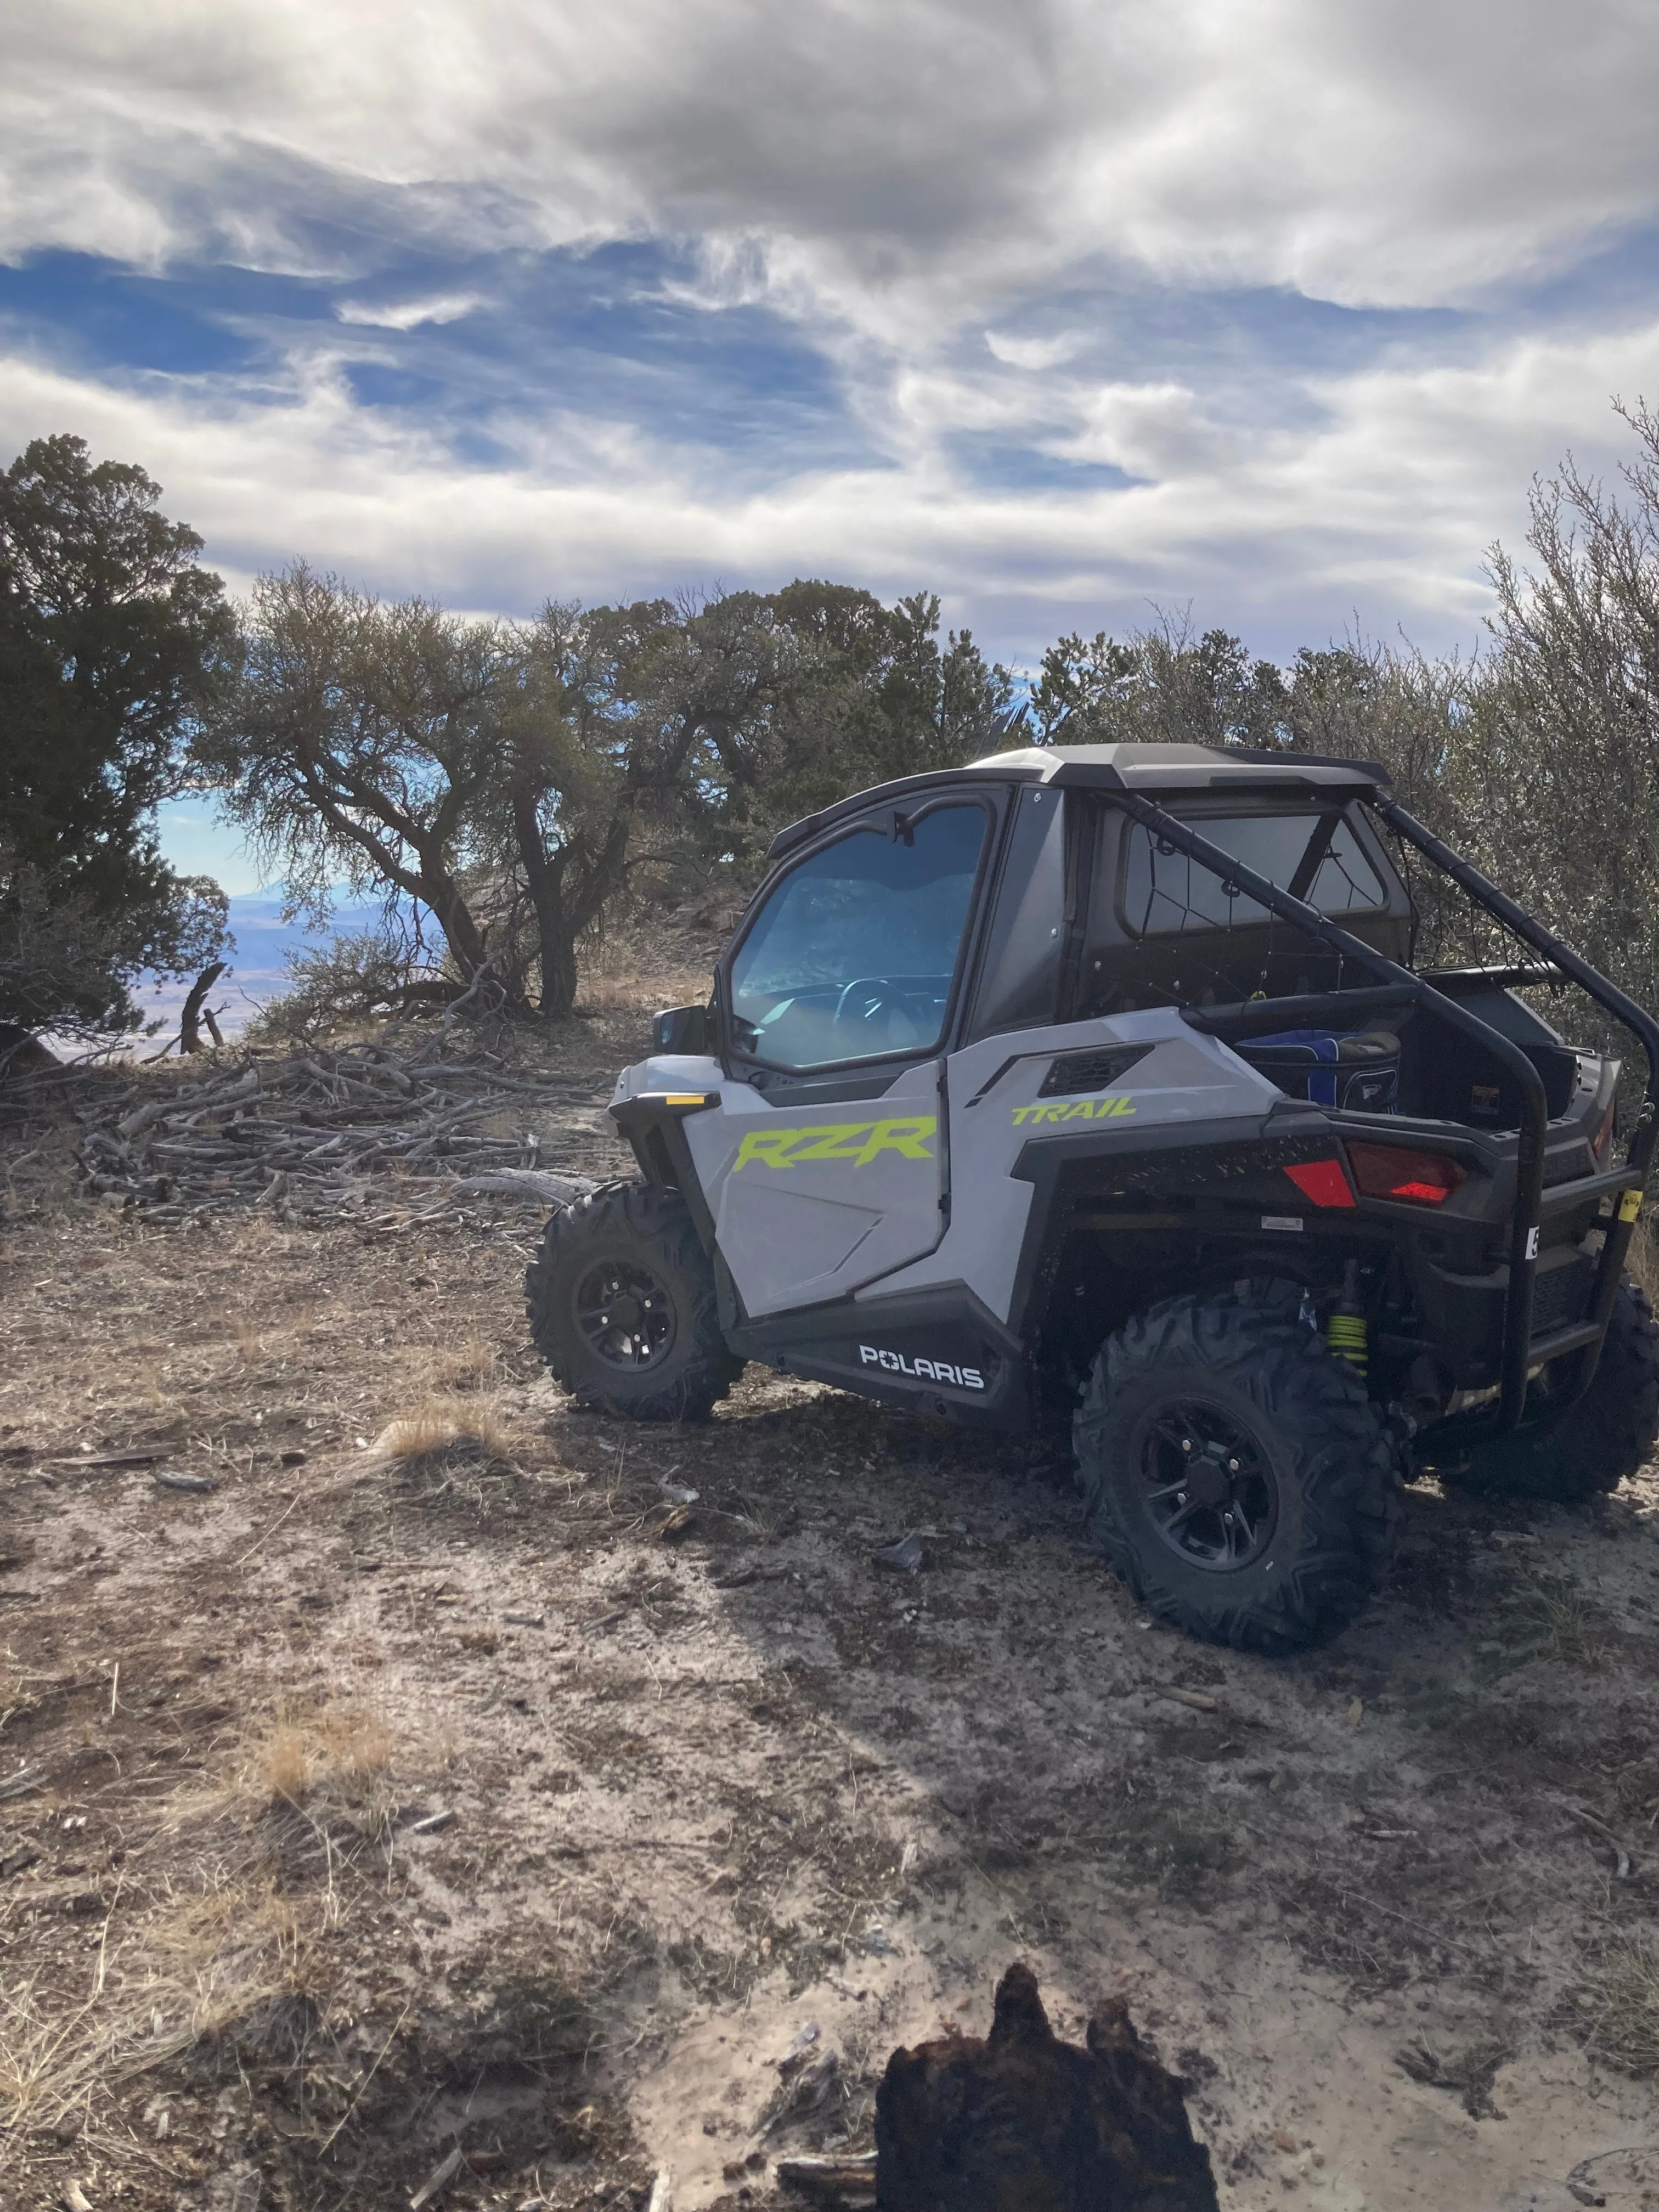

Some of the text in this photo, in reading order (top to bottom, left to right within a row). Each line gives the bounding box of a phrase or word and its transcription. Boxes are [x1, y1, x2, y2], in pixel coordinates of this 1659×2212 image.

[1012, 1096, 1137, 1125] TRAIL
[732, 1116, 937, 1172] RZR
[859, 1345, 984, 1389] POLARIS
